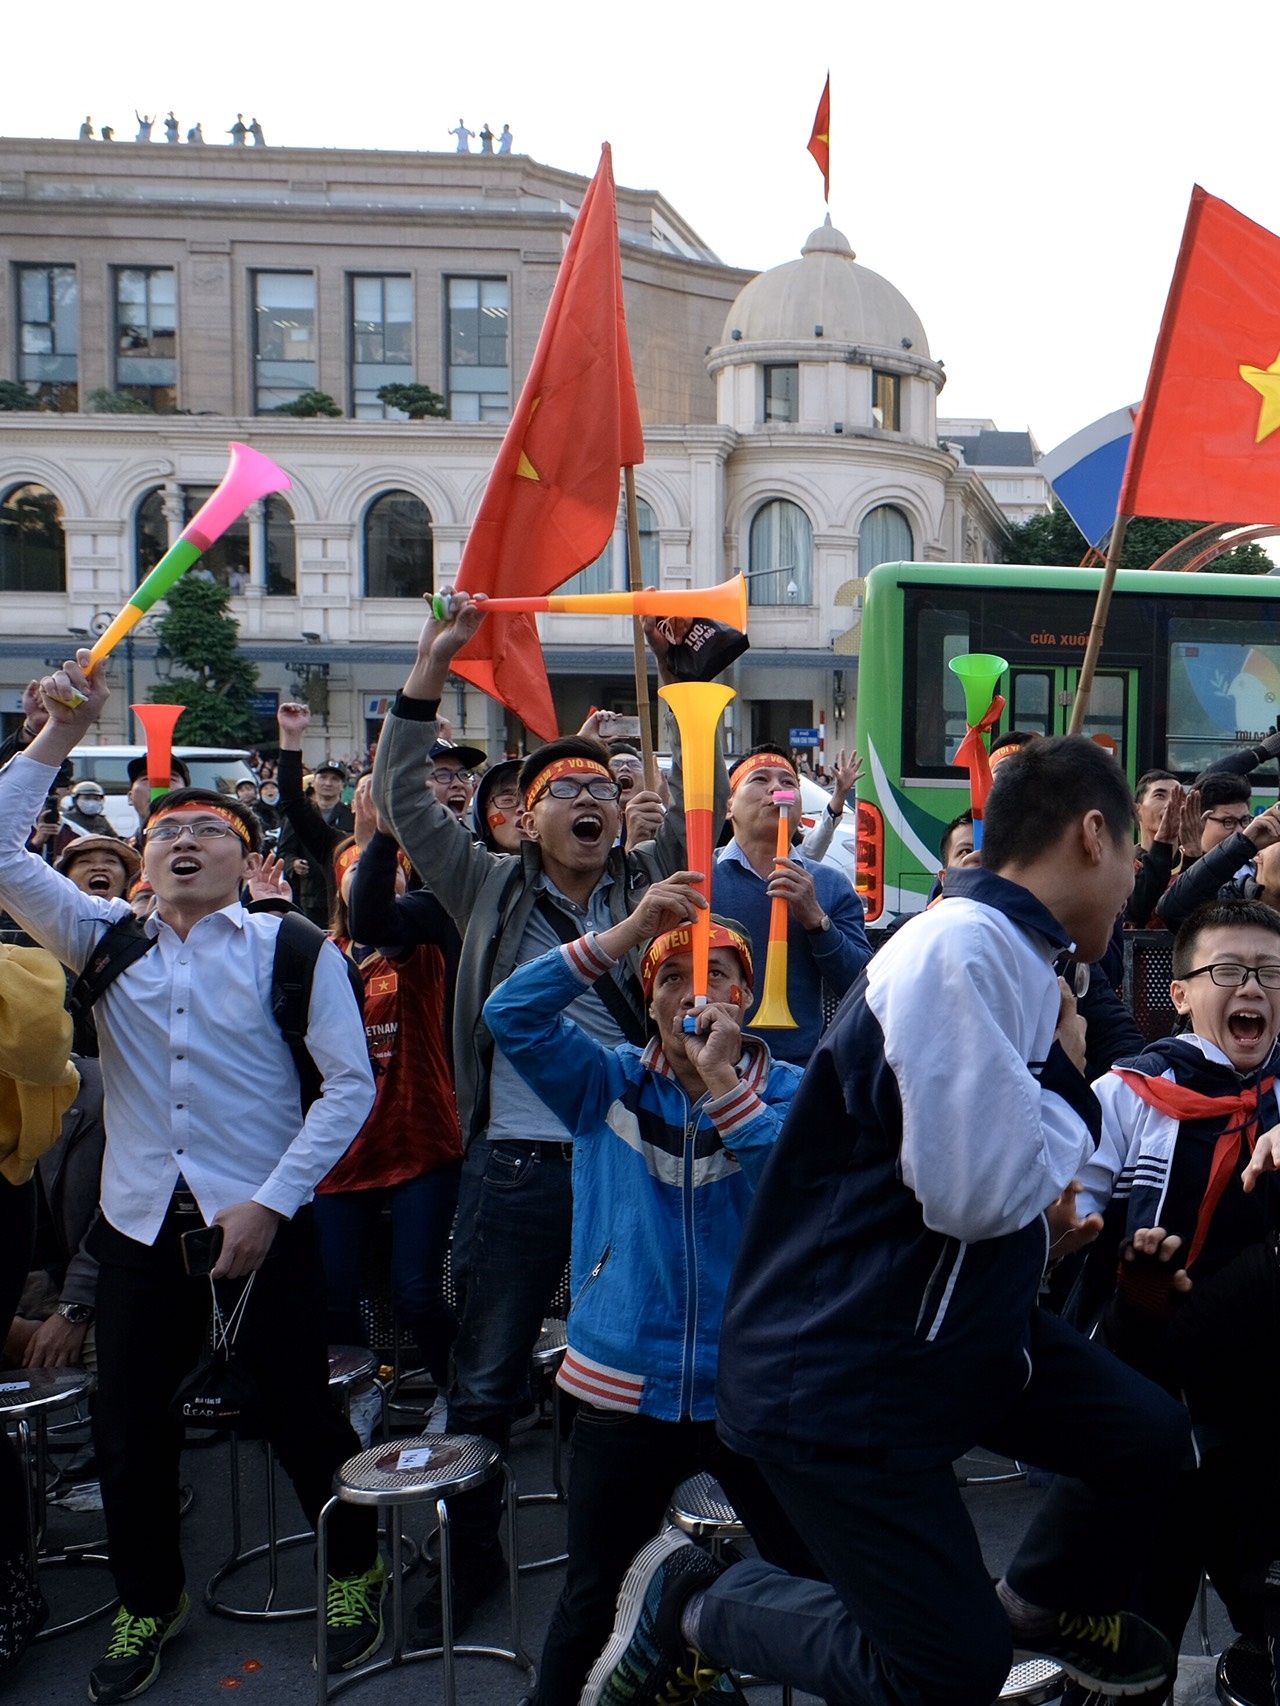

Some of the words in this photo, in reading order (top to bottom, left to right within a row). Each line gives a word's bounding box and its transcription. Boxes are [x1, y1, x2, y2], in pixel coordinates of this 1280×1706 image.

[1030, 629, 1057, 645] CỬA
[1060, 631, 1103, 647] XUỐ
[568, 757, 584, 768] VÔ
[649, 944, 662, 966] TÔI
[663, 930, 690, 950] YÊU
[365, 1022, 399, 1037] ETNAM
